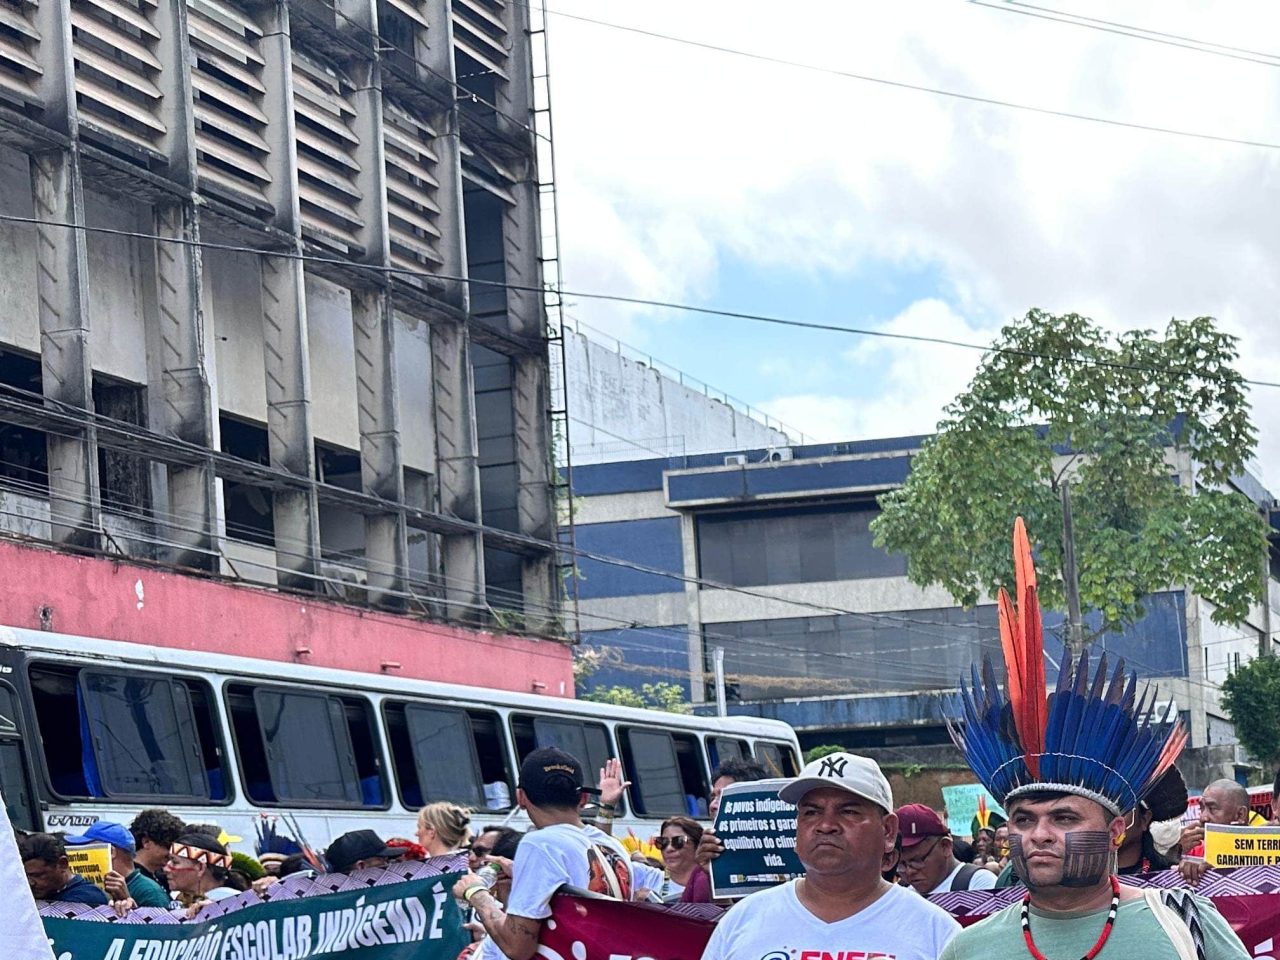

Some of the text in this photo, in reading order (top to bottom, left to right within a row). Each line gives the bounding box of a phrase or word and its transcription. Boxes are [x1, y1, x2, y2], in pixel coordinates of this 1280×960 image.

[732, 801, 755, 815] povos
[729, 817, 769, 833] primeiros
[769, 819, 776, 830] a
[776, 818, 798, 831] gara
[723, 836, 763, 851] equilíbrio
[763, 836, 775, 848] do
[1235, 838, 1255, 850] SEM
[763, 853, 786, 866] vida.
[1217, 855, 1264, 865] GARANTIDO
[309, 895, 426, 956] INDÍGENA
[429, 881, 448, 939] É
